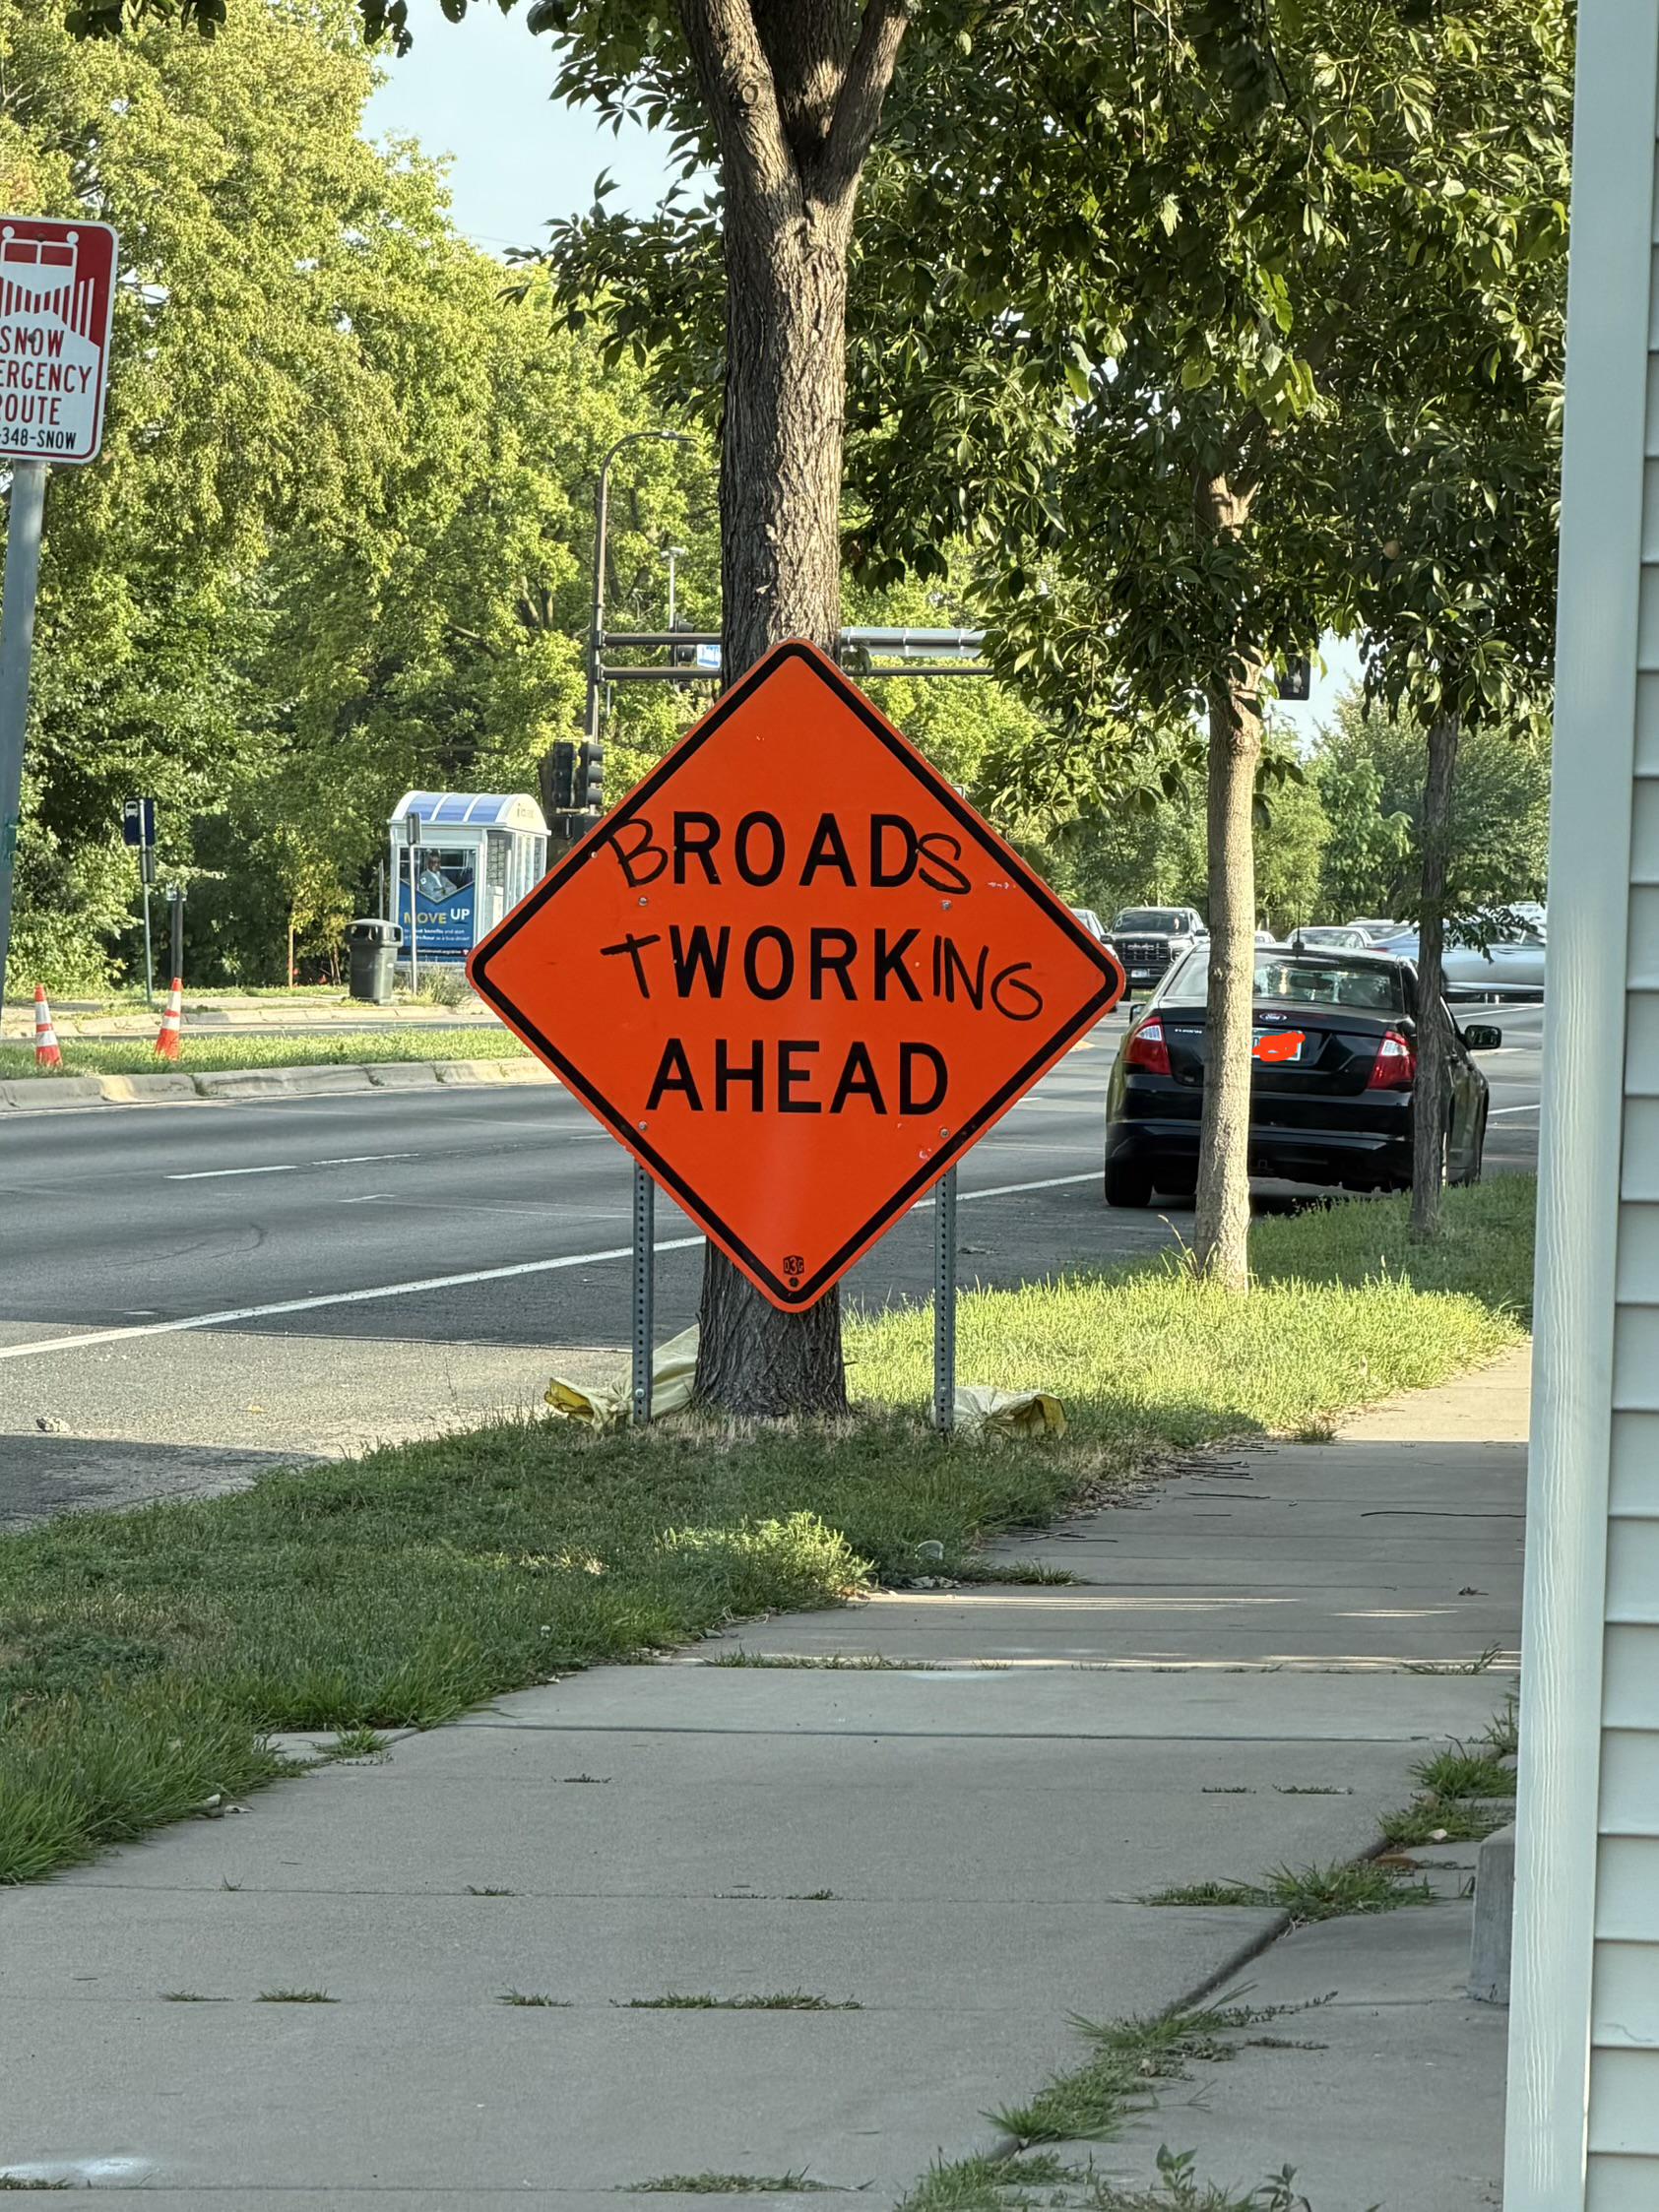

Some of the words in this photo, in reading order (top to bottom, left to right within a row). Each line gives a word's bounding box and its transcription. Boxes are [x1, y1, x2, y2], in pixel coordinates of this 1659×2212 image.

[0, 325, 65, 358] SNOW
[0, 393, 62, 425] OUTE
[0, 426, 77, 450] 348-SNOW
[606, 810, 972, 895] BROADS
[404, 912, 447, 924] MOVE
[450, 908, 471, 920] UP
[601, 924, 1044, 1021] TWORKING
[645, 1038, 949, 1115] AHEAD
